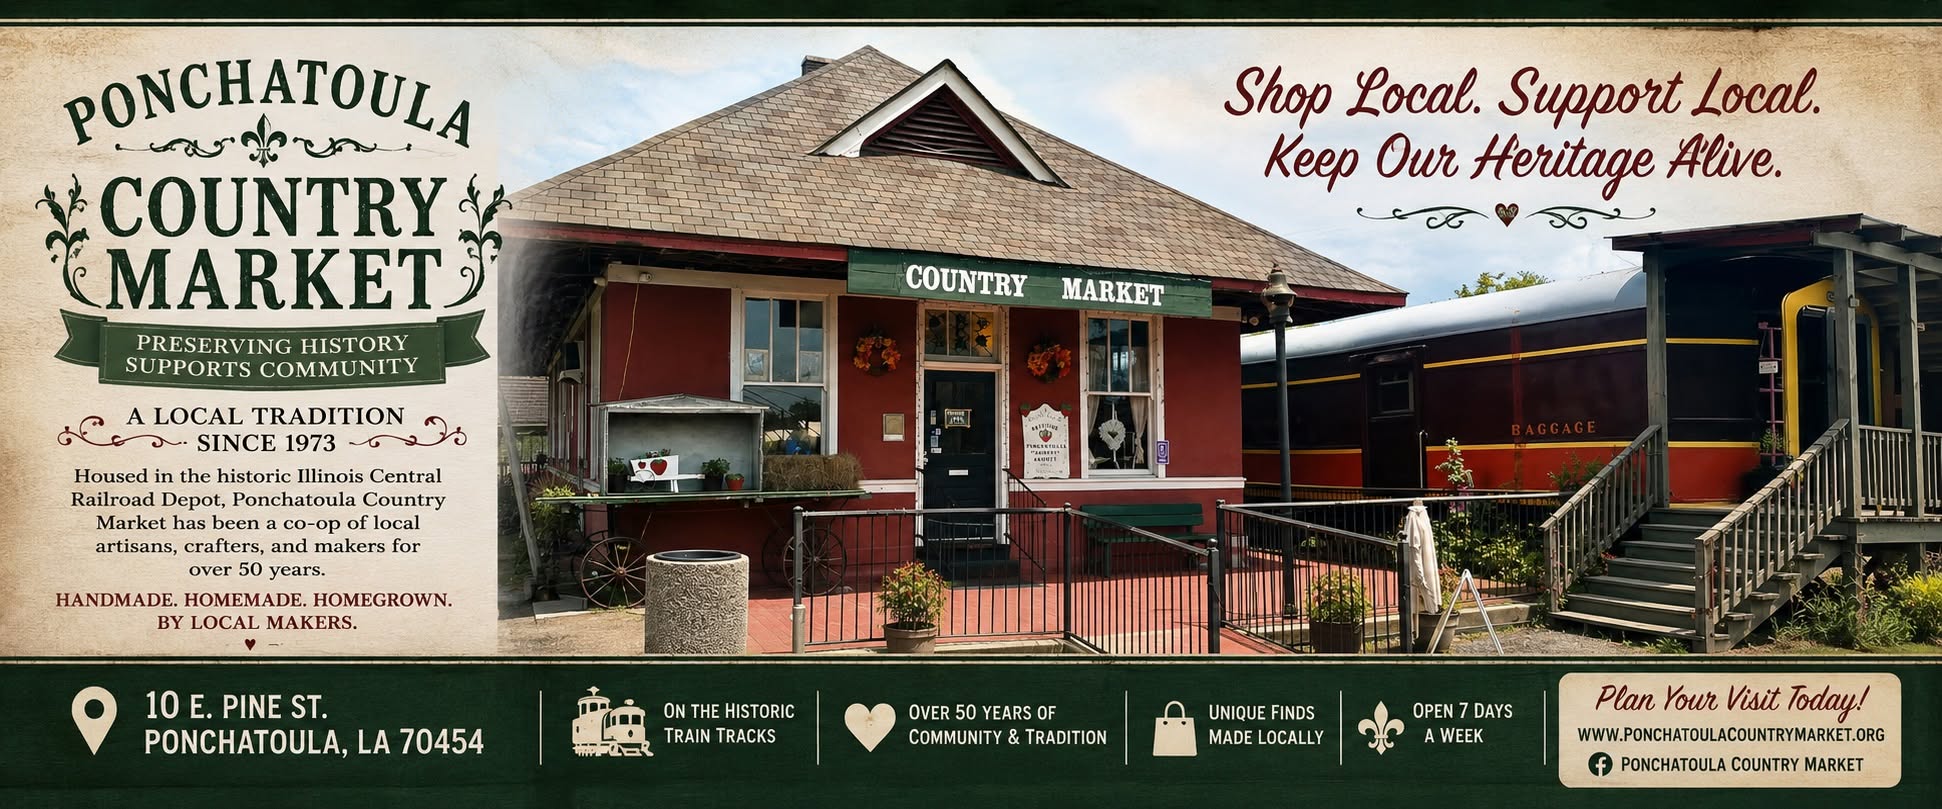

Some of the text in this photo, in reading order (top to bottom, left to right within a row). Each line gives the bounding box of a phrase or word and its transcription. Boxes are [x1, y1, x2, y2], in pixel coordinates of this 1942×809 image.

[905, 264, 1165, 307] COUNTRY MARKET
[1511, 420, 1595, 436] BAGGAGE
